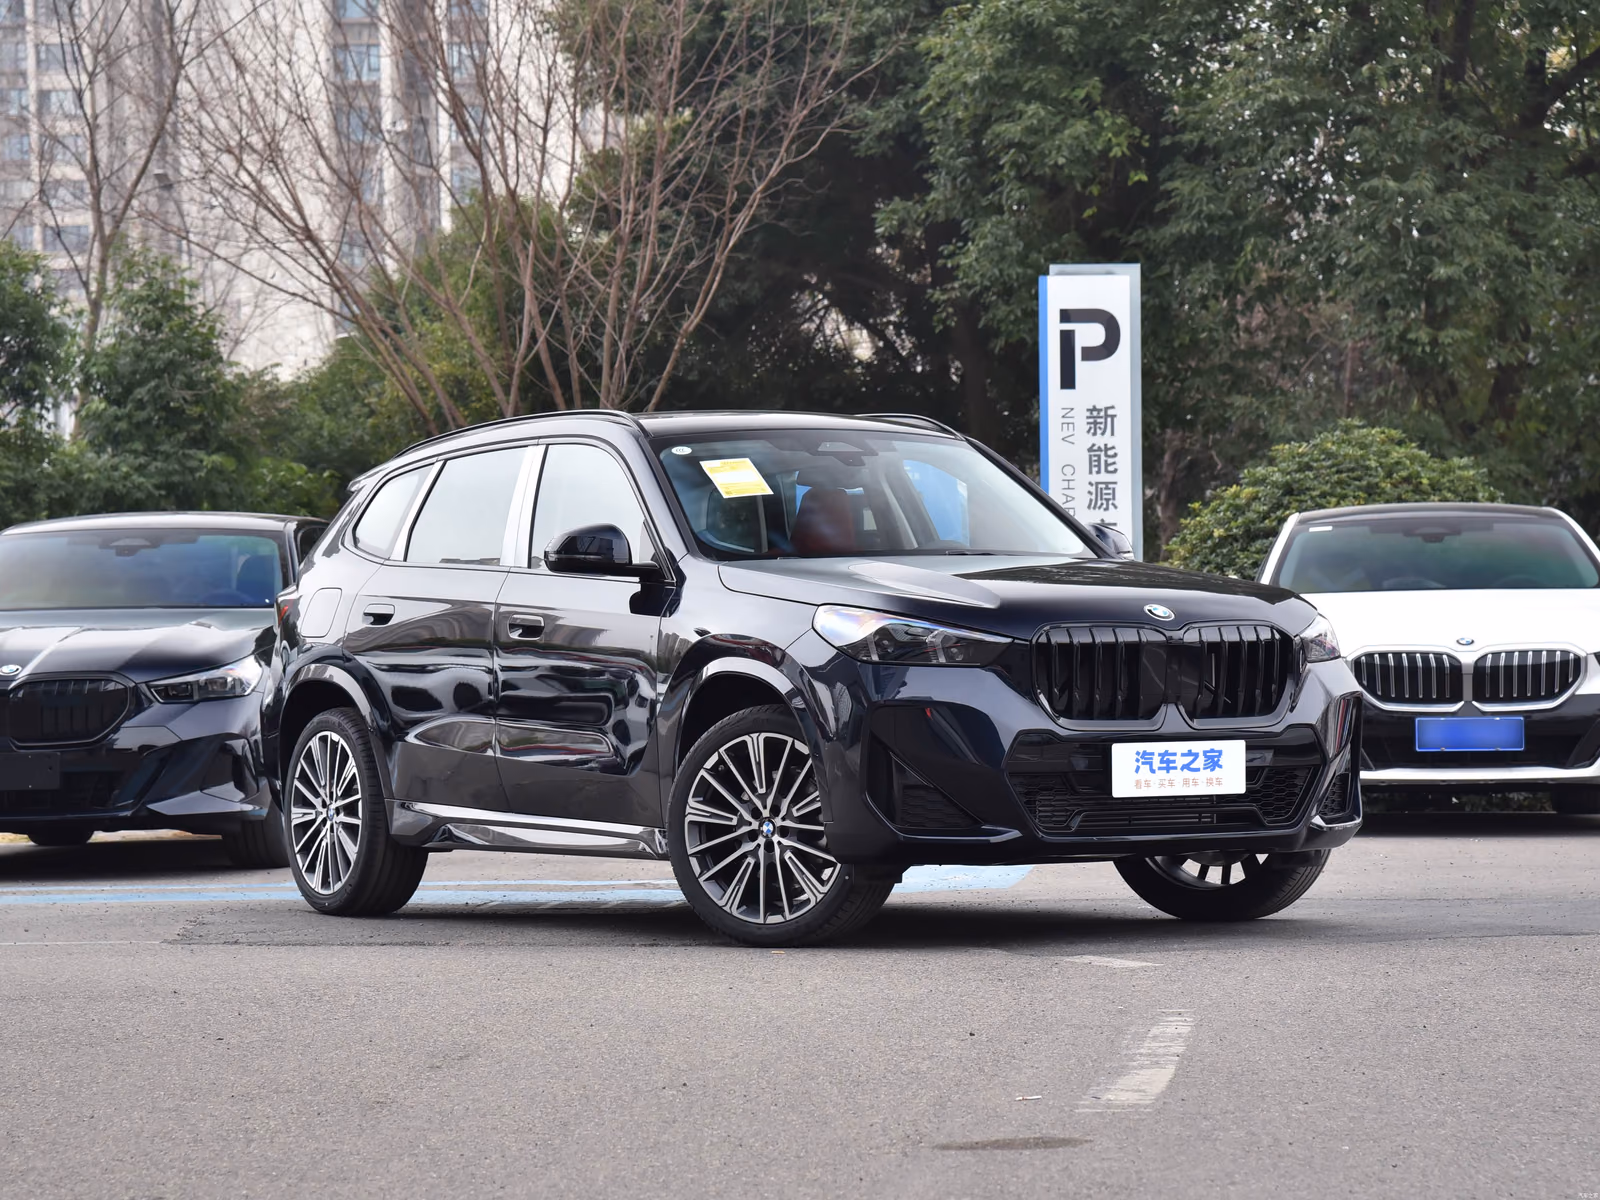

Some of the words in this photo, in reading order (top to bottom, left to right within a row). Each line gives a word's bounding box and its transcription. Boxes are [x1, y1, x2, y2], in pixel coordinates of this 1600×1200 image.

[1059, 308, 1121, 390] P
[1060, 407, 1075, 445] NEV
[1085, 404, 1118, 526] 新能源
[1134, 748, 1223, 774] 汽车之家
